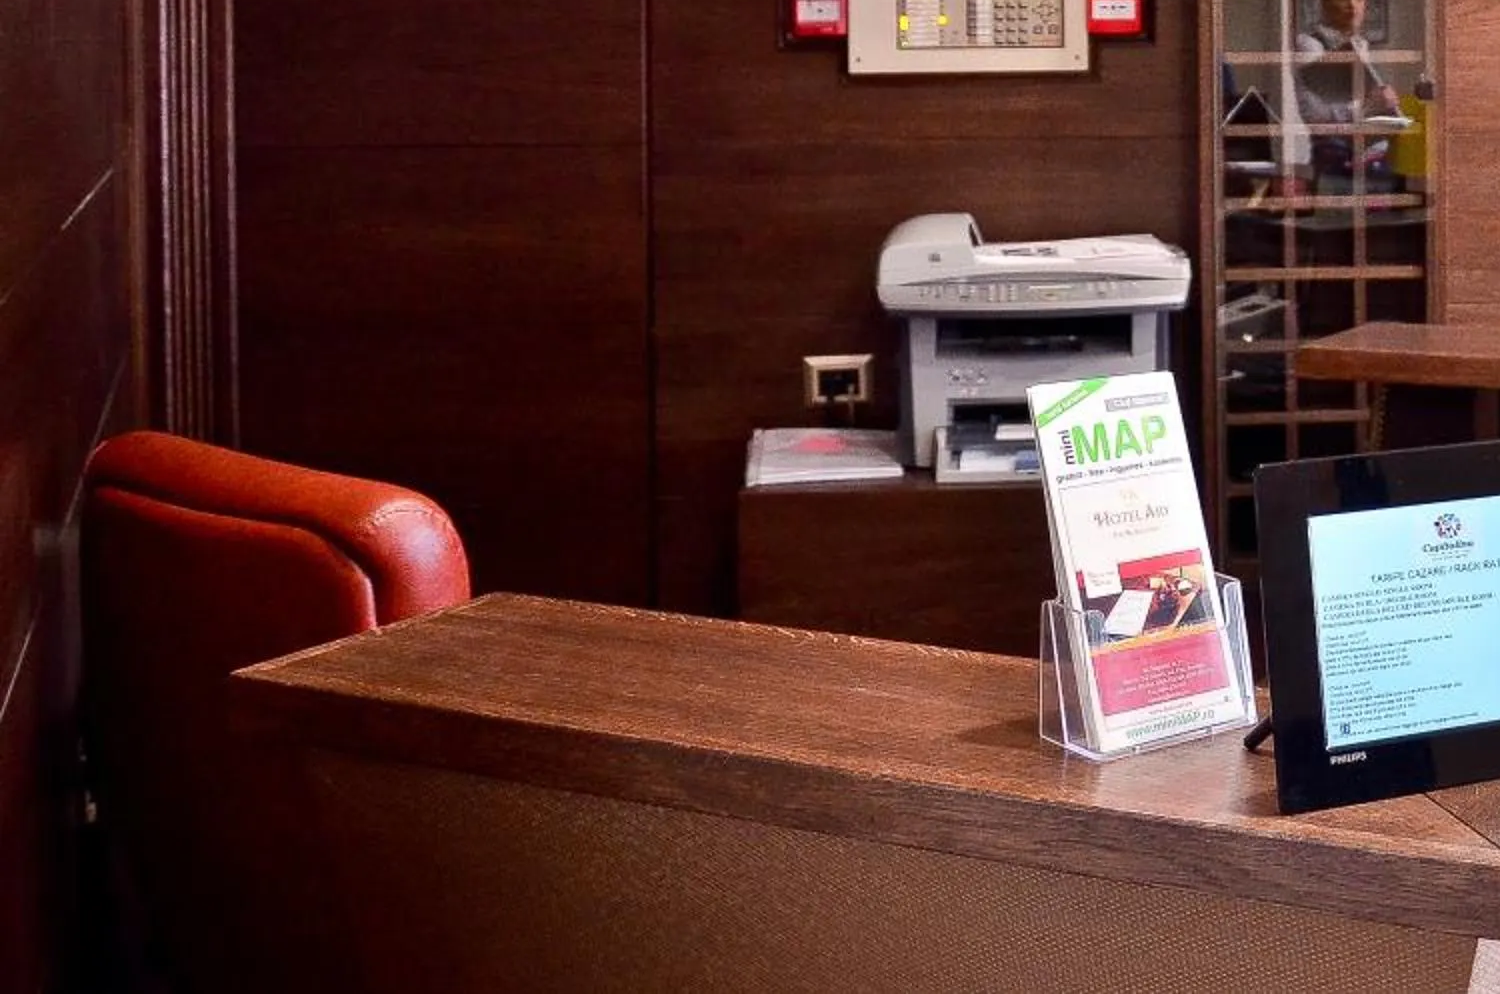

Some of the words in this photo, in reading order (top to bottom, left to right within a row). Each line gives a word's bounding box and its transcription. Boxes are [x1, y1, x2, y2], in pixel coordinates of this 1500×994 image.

[1058, 430, 1075, 464] mini
[1071, 415, 1167, 464] MAP
[1093, 509, 1144, 526] HOTEL
[1330, 751, 1367, 766] PHILIPS
